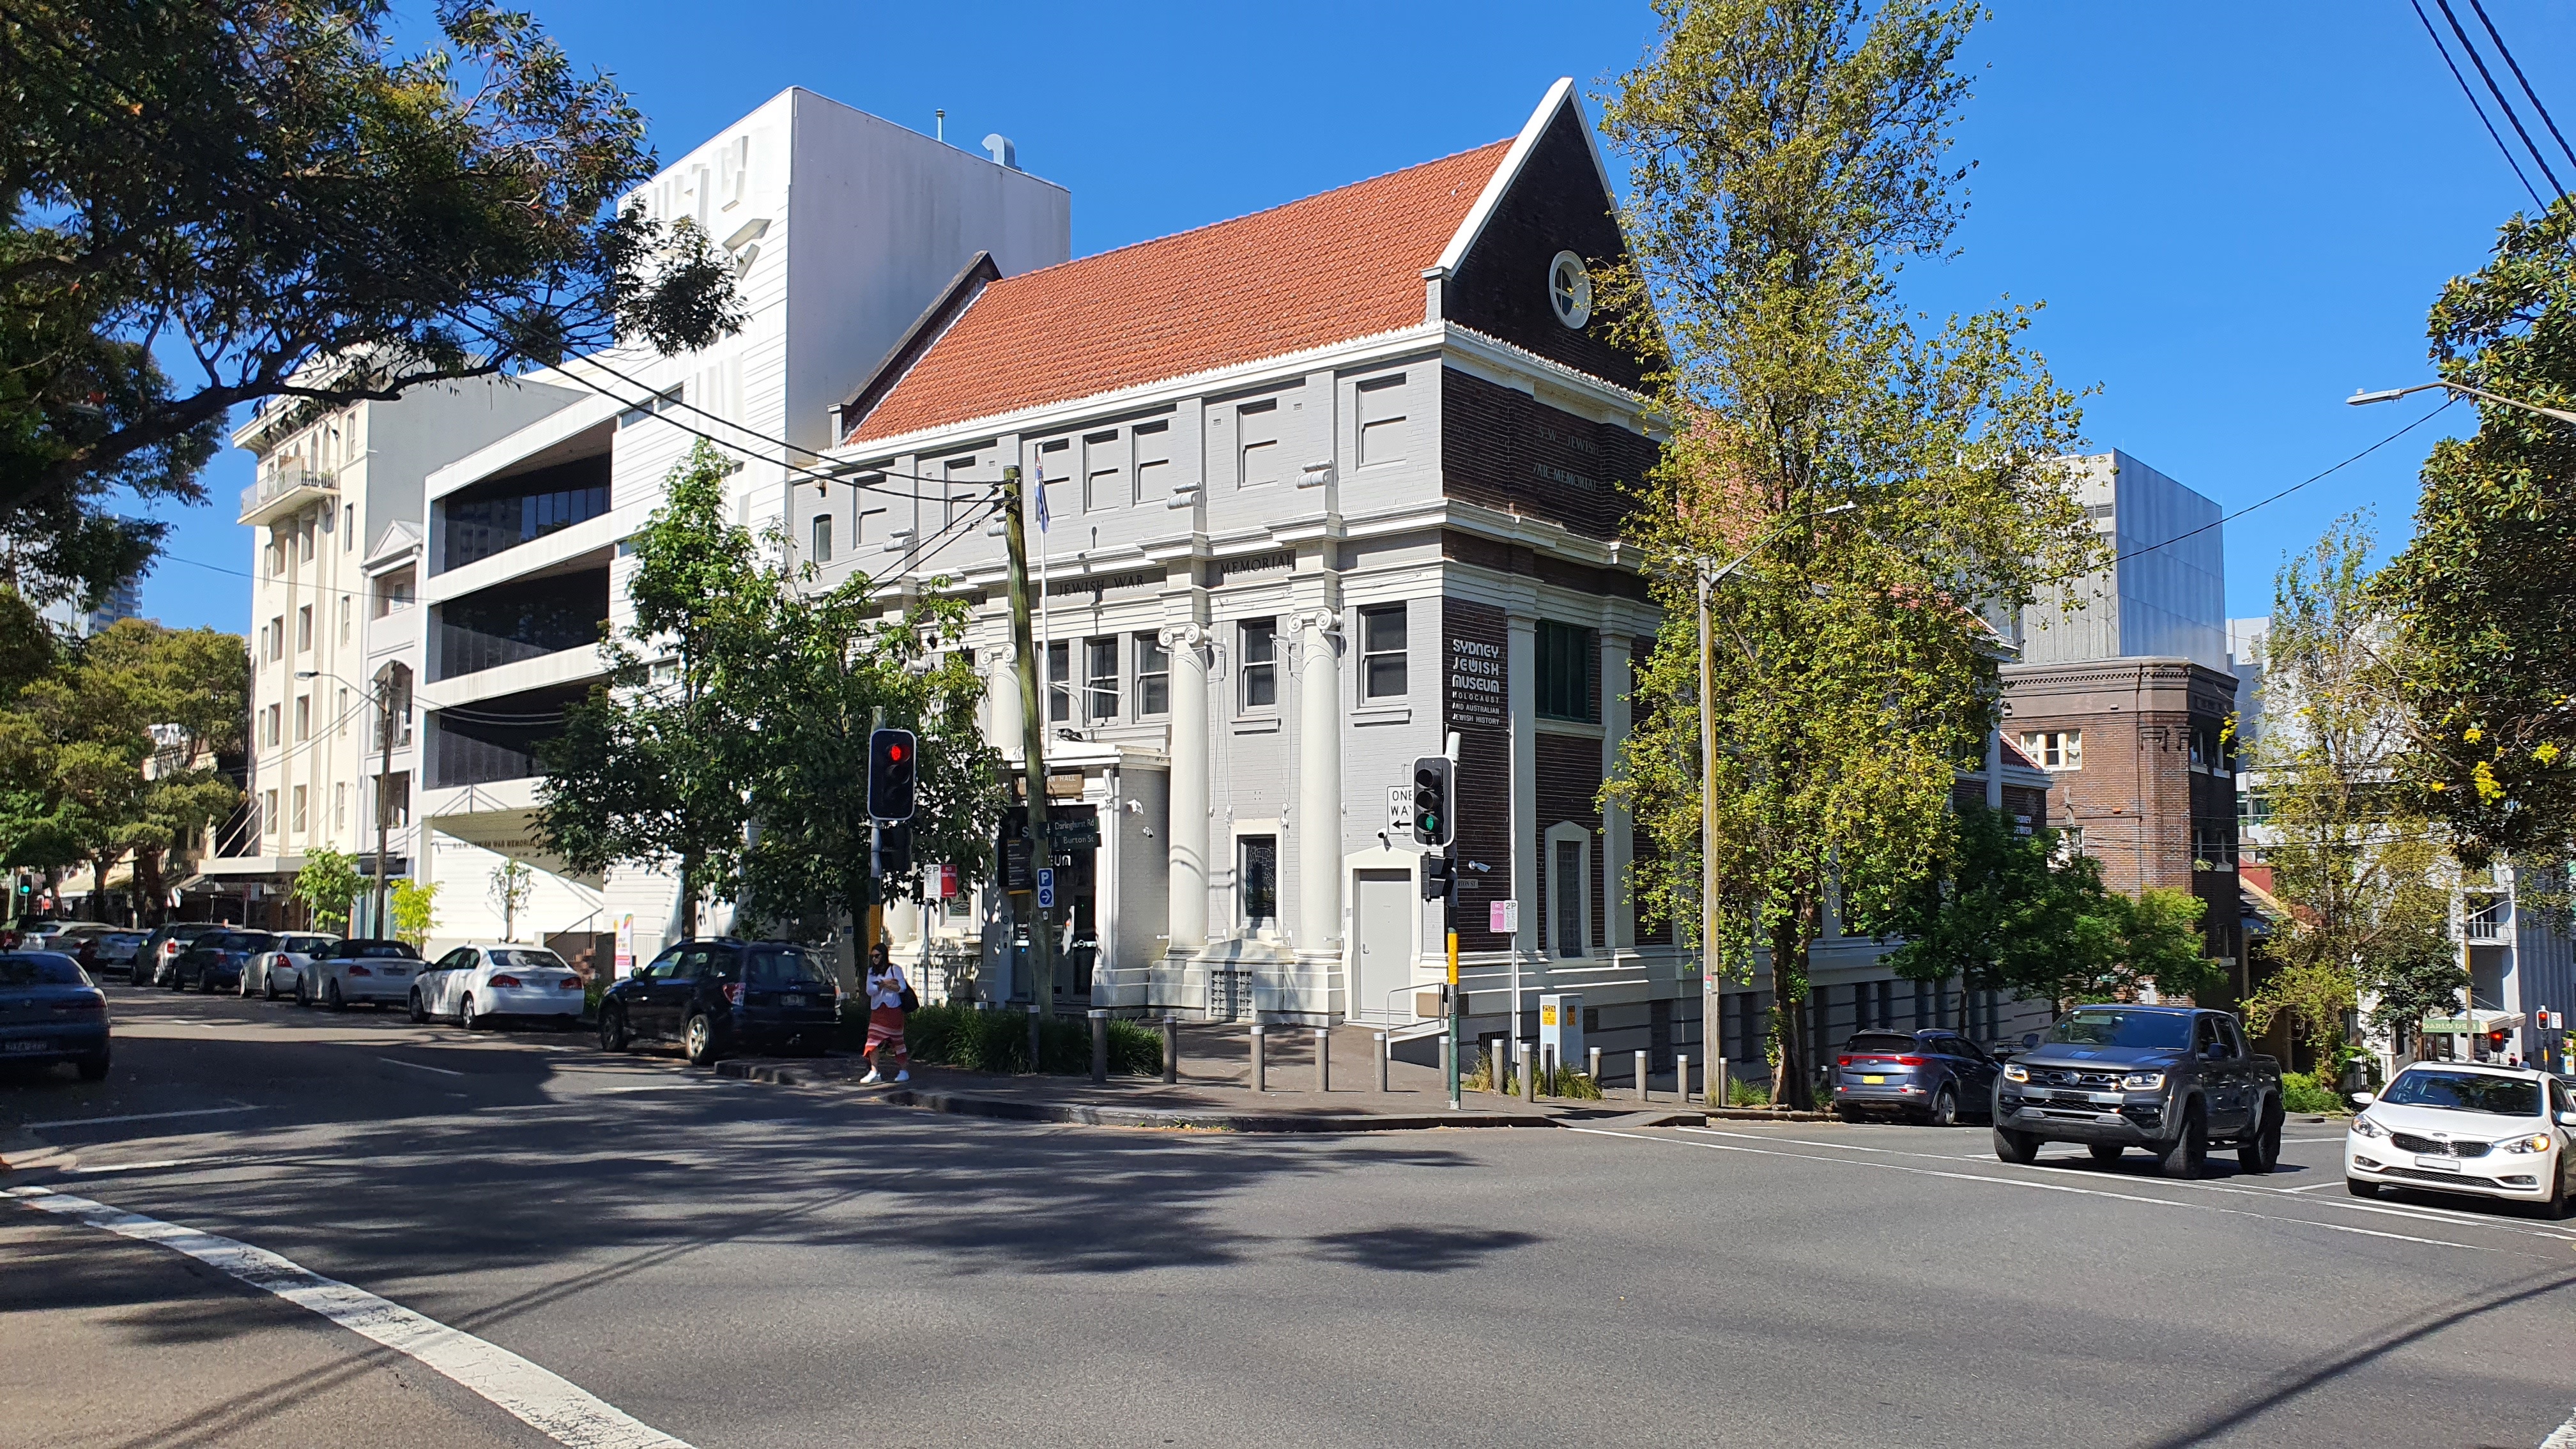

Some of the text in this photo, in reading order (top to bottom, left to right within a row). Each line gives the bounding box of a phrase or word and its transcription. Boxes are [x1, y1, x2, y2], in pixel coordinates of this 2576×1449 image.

[1567, 435, 1598, 456] JEWISH
[1553, 468, 1596, 491] MEMORIAL
[1057, 579, 1105, 597] JEWISH
[1114, 574, 1145, 590] WAR
[1220, 554, 1294, 576] MEMORIAL
[1453, 639, 1499, 659] SYDNEY
[1453, 656, 1499, 676] JEWISH
[1452, 674, 1499, 693] MUSEUM
[1452, 691, 1499, 703] HOLOCAUST
[1452, 702, 1499, 715] AND AUSTRALIAN
[1452, 713, 1499, 725] JEWISH HISTORY
[1392, 790, 1412, 801] ONE
[1055, 818, 1094, 831] Darlinghurst Rd
[925, 866, 939, 875] 2P
[1041, 871, 1050, 884] P
